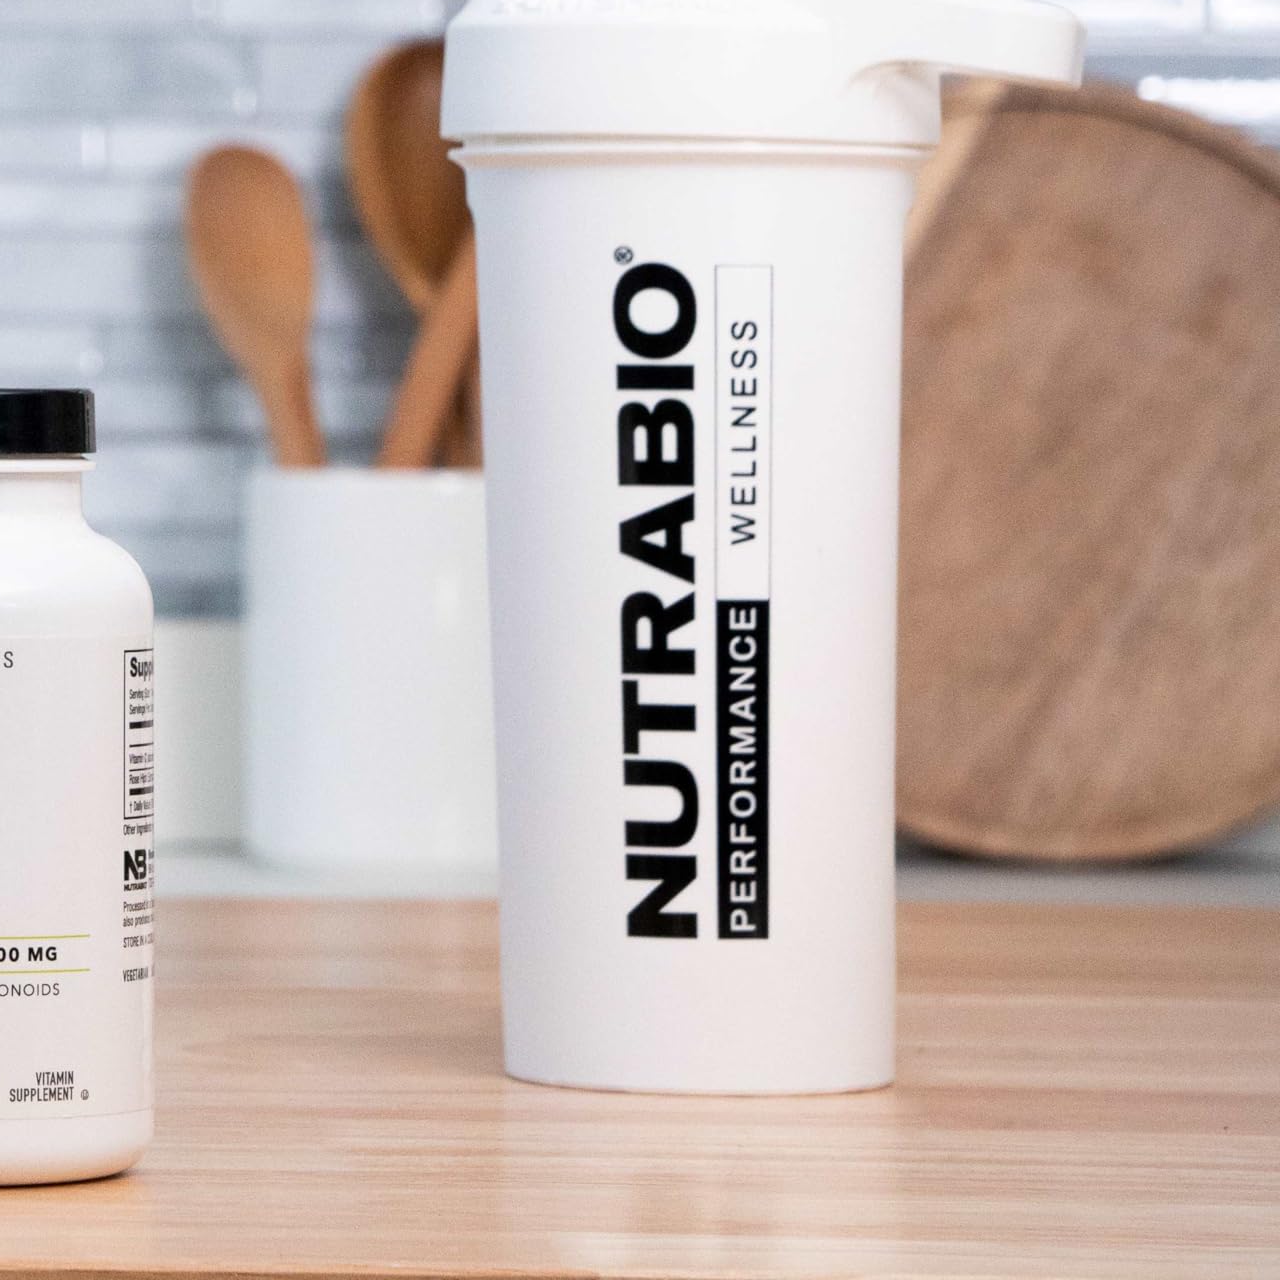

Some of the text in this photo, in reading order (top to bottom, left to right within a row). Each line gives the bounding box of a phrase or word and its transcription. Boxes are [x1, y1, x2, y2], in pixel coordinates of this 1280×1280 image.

[729, 320, 758, 545] WELLNESS
[728, 607, 757, 932] PERFORMANCE
[28, 946, 58, 962] MG
[36, 1071, 74, 1085] VITAMIN
[9, 1087, 74, 1102] SUPPLEMENT
